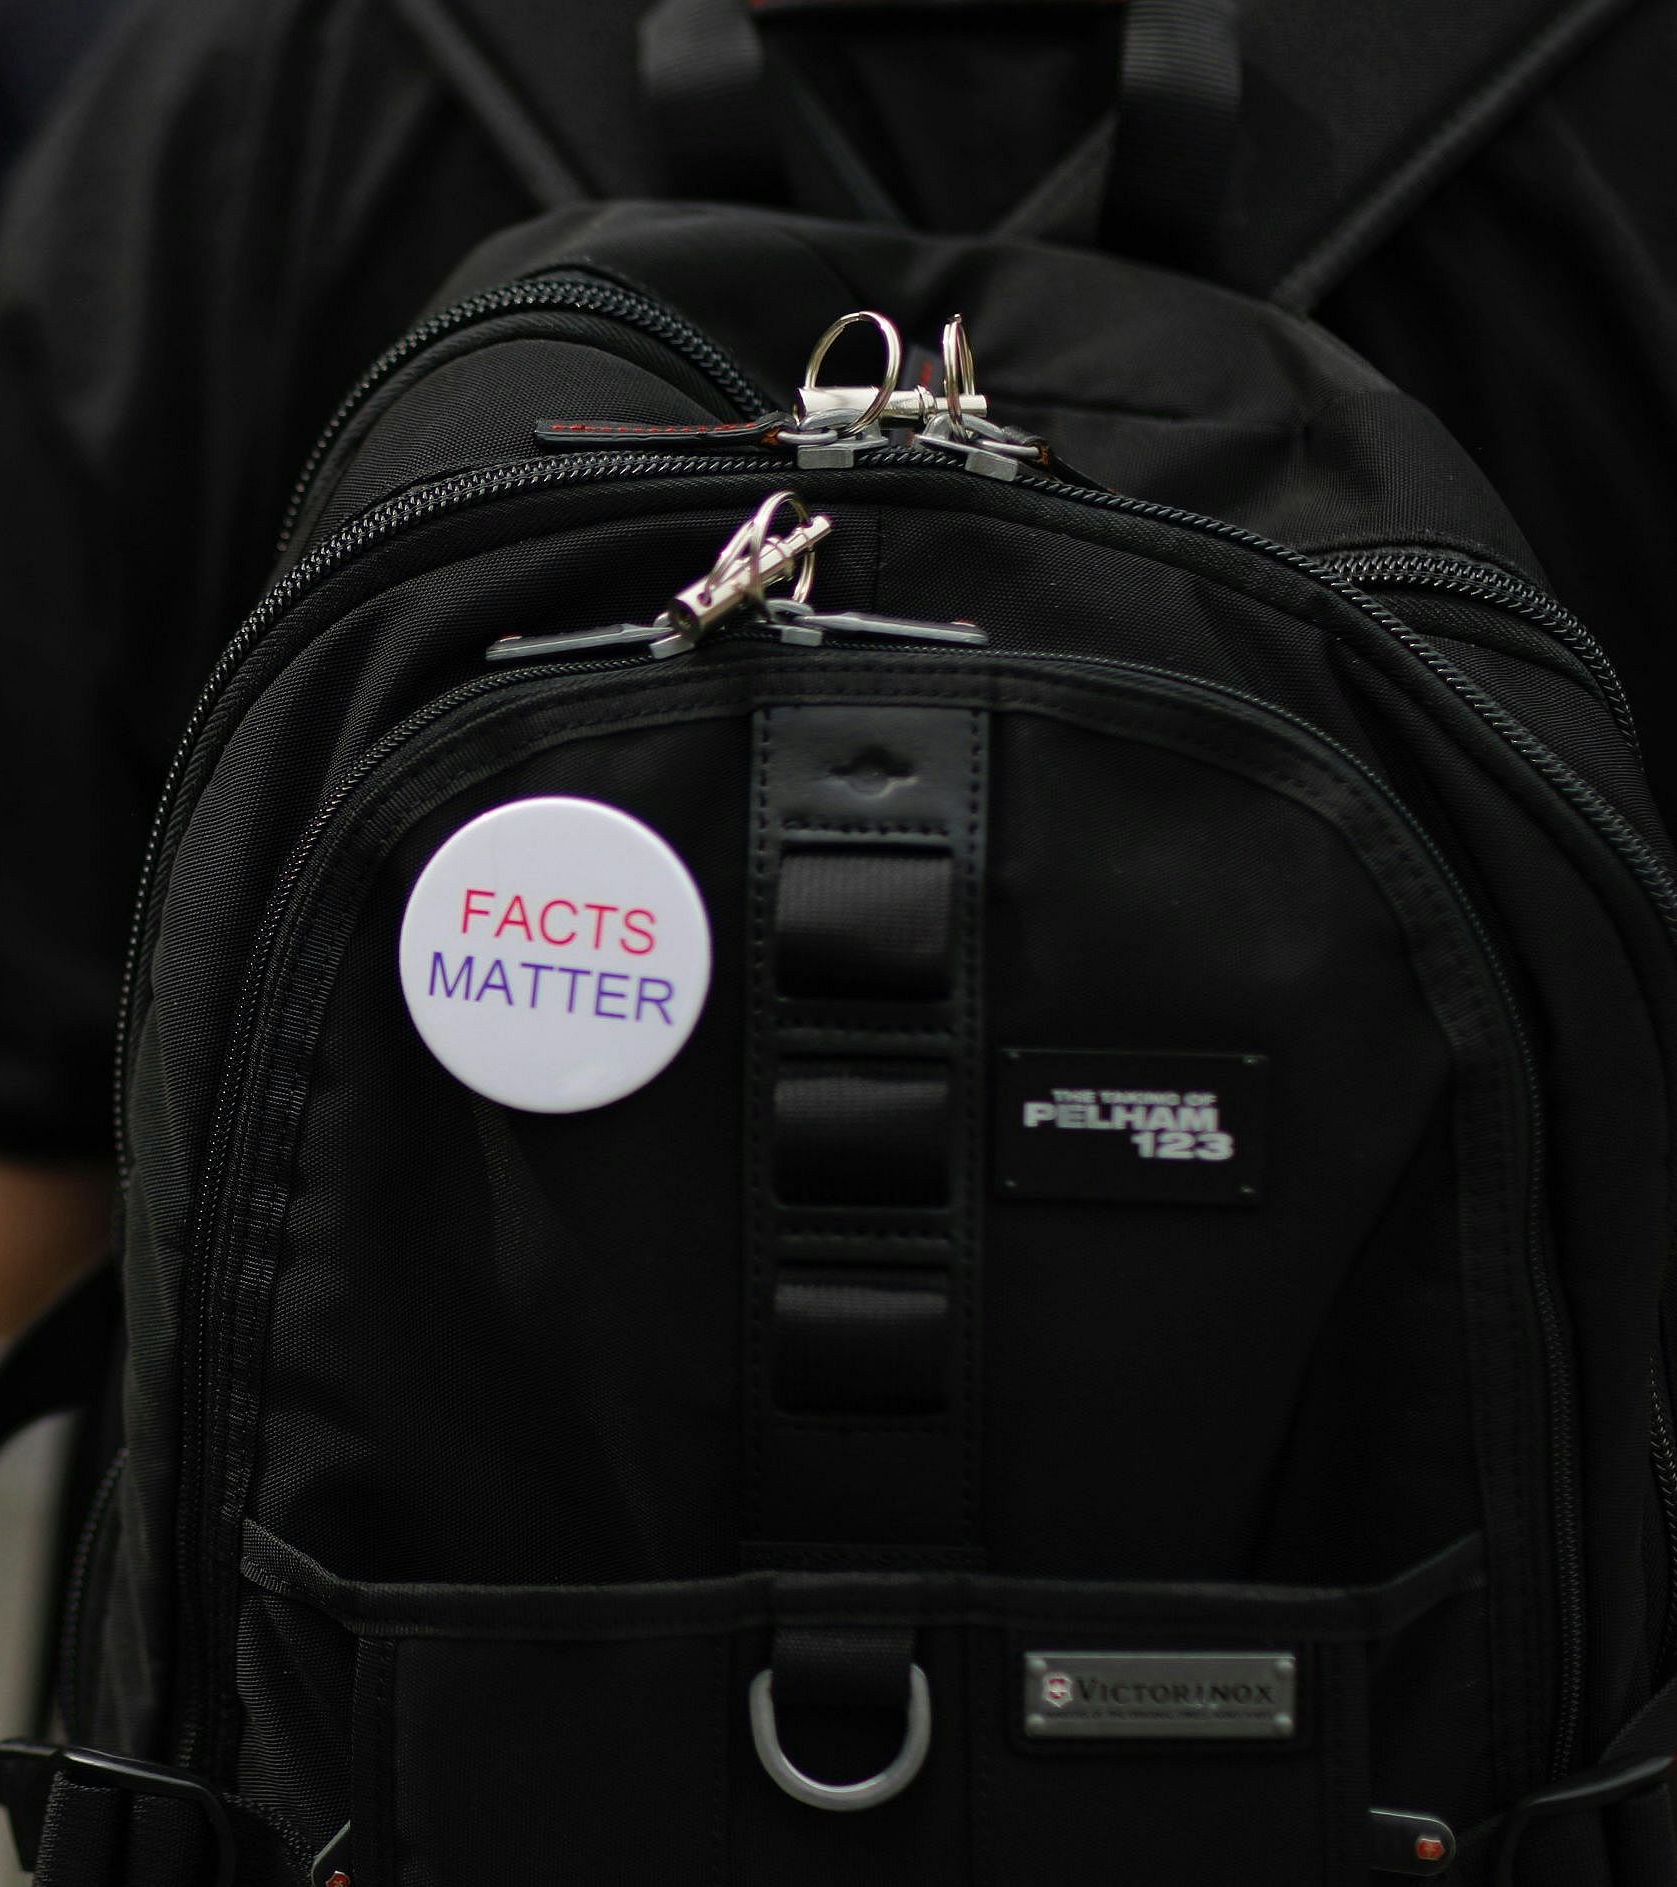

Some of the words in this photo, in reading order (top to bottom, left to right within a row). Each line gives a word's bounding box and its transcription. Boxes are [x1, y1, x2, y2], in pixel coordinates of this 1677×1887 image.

[462, 888, 656, 956] FACTS
[428, 951, 675, 1026] MATTER
[1051, 1089, 1096, 1103] THE
[1183, 1092, 1217, 1106] OF
[1023, 1102, 1218, 1131] PELHAM
[1131, 1131, 1234, 1160] 123
